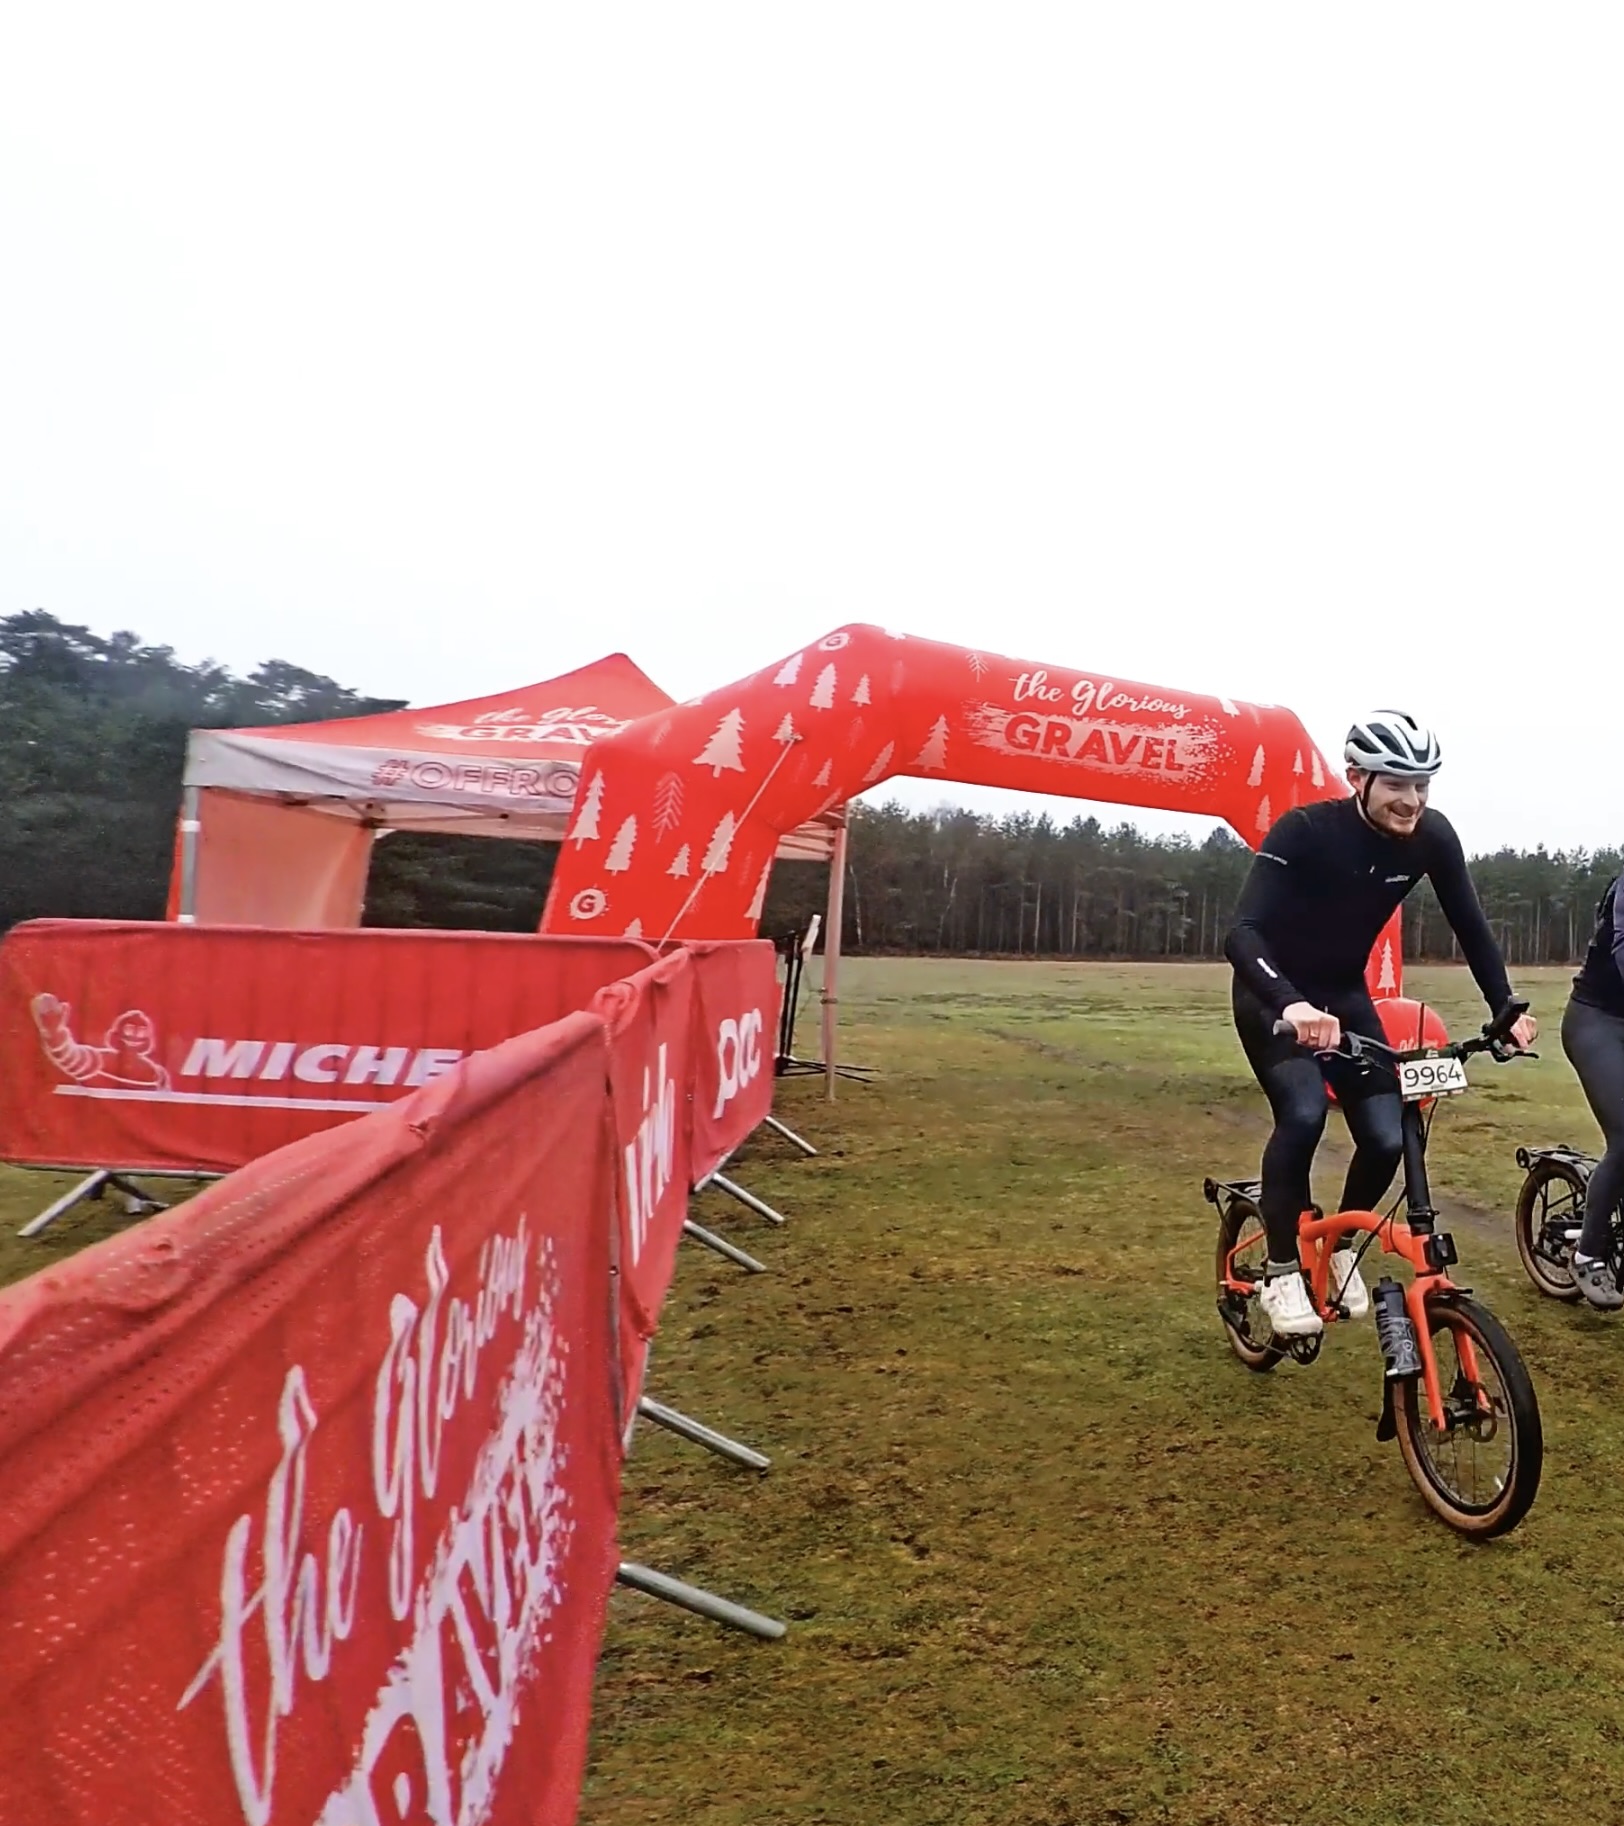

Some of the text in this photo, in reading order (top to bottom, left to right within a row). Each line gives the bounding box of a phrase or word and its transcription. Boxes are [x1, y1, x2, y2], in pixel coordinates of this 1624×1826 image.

[1009, 670, 1064, 702] the
[1003, 714, 1186, 772] GRAVEL
[1404, 1064, 1462, 1088] 9964
